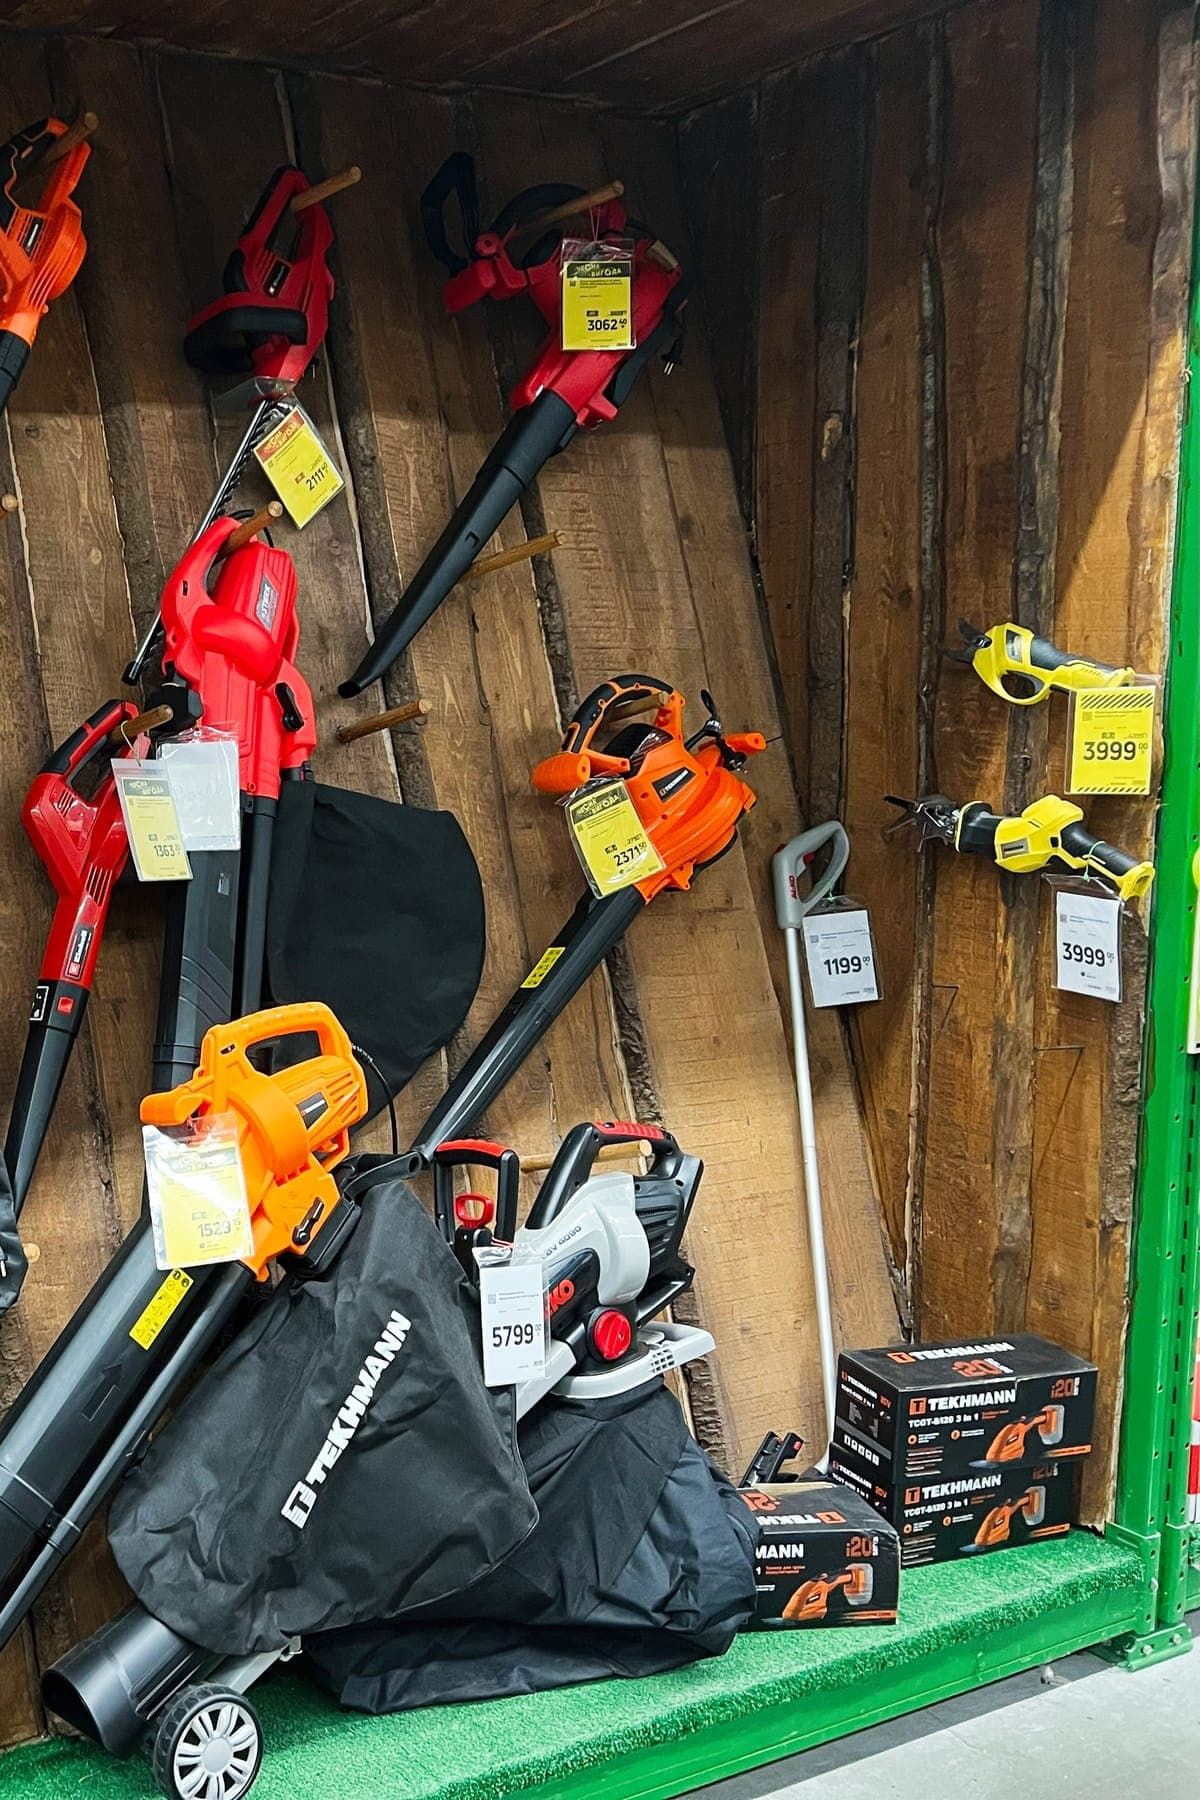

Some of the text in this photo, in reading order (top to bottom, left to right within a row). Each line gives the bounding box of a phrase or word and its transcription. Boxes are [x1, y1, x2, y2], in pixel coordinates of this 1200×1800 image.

[588, 319, 618, 331] 3062
[306, 468, 325, 491] 2111
[1083, 741, 1148, 760] 3999 00
[154, 844, 175, 857] 1363
[613, 845, 641, 866] 2371
[1062, 941, 1105, 968] 3999
[824, 956, 862, 976] 1199
[492, 1323, 534, 1348] 5799
[908, 1342, 1016, 1360] TEKHMANN
[304, 1309, 412, 1485] TEKHMANN
[928, 1389, 1016, 1411] TEKHMANN
[974, 1412, 979, 1421] 1
[922, 1474, 1002, 1500] TEKHMANN
[963, 1498, 968, 1506] 1
[845, 1536, 873, 1558] i20
